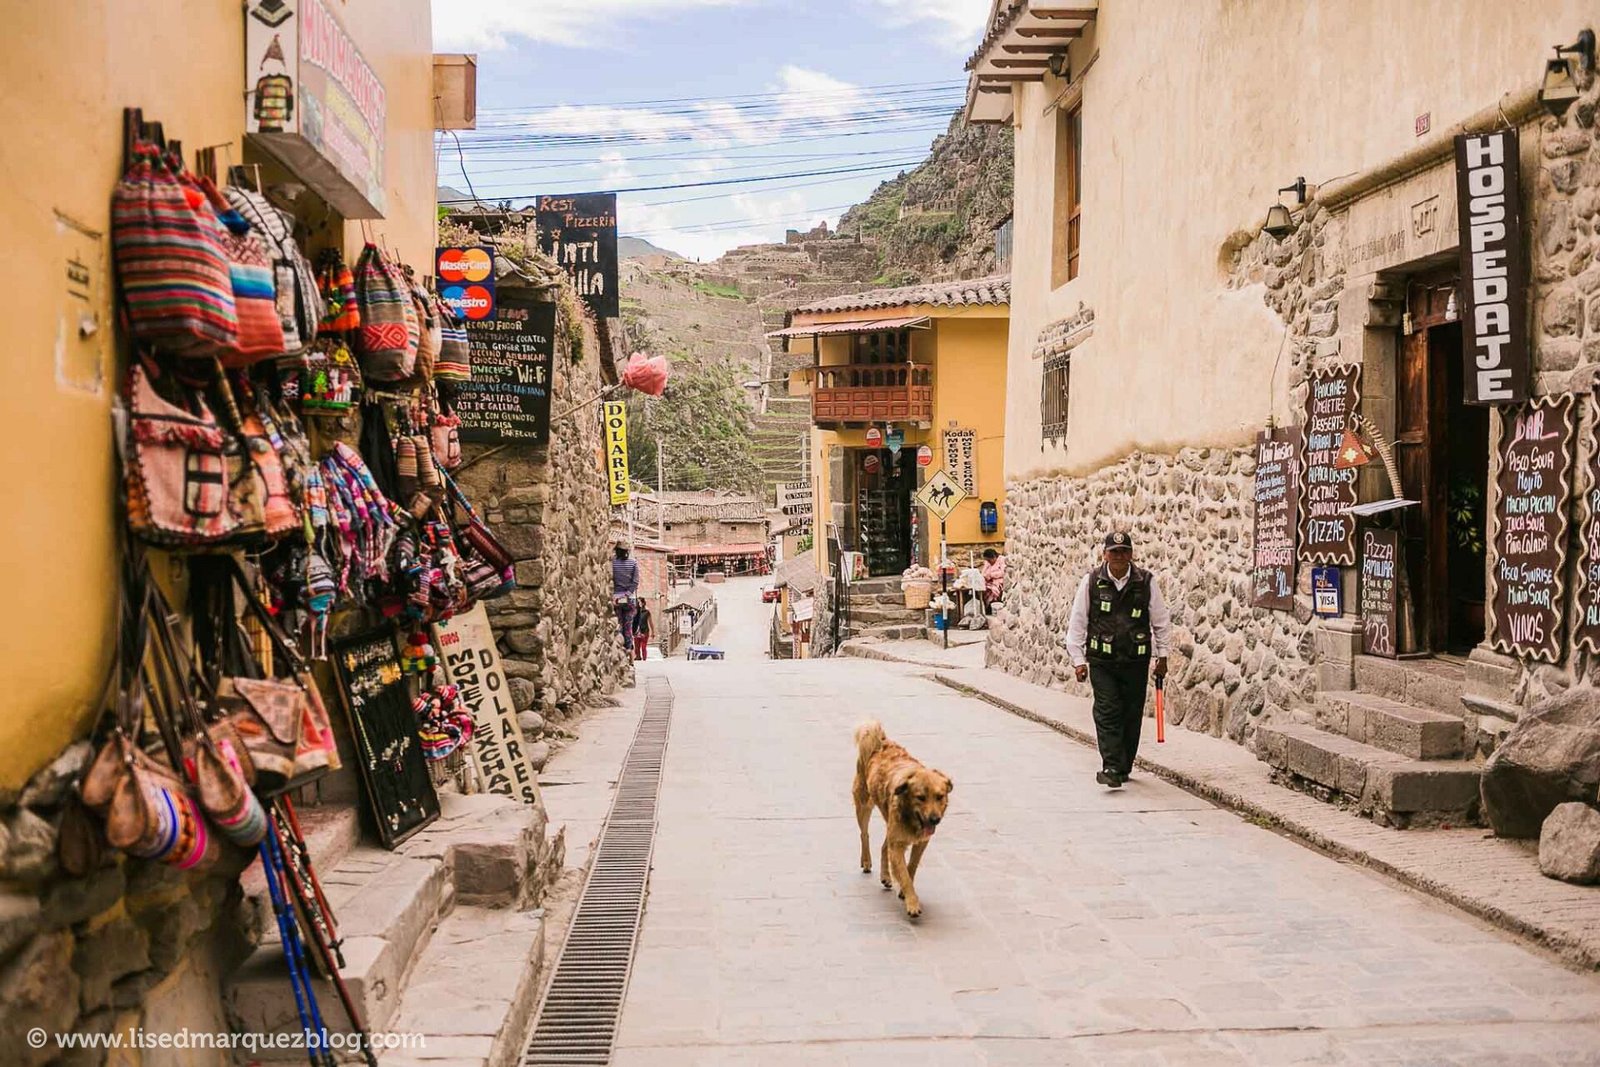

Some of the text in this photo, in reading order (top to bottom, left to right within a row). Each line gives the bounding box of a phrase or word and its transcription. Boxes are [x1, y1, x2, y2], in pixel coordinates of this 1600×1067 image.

[440, 261, 489, 271] MasterCard
[1466, 135, 1514, 401] HOSPEDAJE
[444, 298, 489, 308] Maestro
[472, 365, 514, 376] DWICHES
[485, 411, 500, 420] CON
[944, 430, 975, 438] Kodak
[609, 405, 626, 494] DOLARES
[962, 438, 972, 459] MONEY
[1306, 519, 1345, 545] PIZZAS
[1320, 596, 1336, 606] VISA
[1507, 612, 1544, 644] VINOS
[447, 648, 517, 802] MONEY EXCHAN
[478, 649, 537, 805] DOLARES
